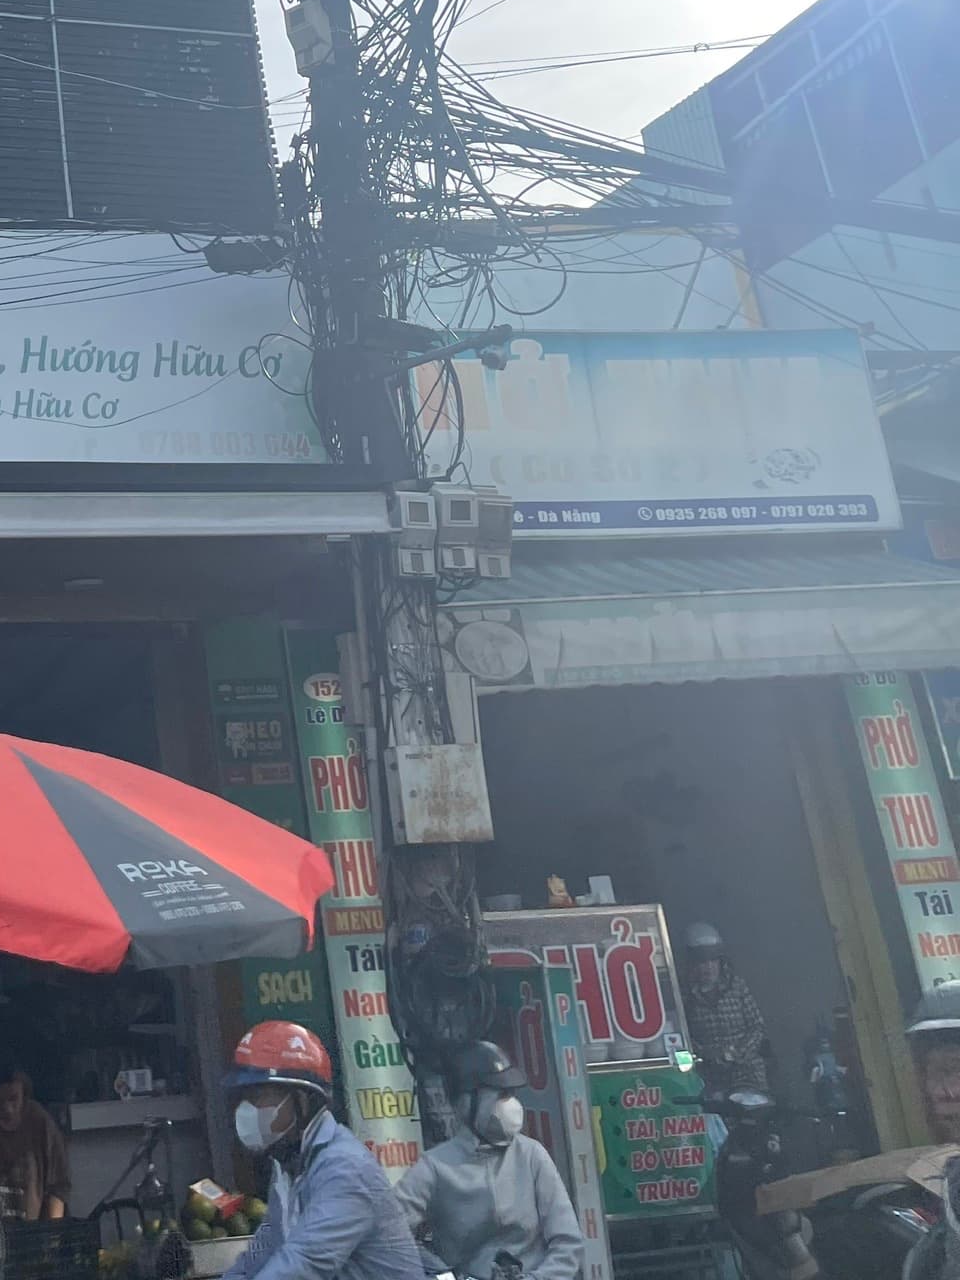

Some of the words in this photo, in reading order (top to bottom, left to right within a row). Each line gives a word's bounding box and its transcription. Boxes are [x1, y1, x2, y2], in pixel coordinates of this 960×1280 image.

[153, 340, 228, 378] Hữu
[239, 344, 283, 379] Cơ
[12, 389, 74, 419] Hữu
[82, 393, 120, 419] Cơ
[310, 680, 342, 697] 152
[863, 701, 920, 768] PHỞ
[309, 738, 368, 812] PHỞ
[882, 796, 940, 849] THU
[117, 859, 208, 883] ROKA
[915, 891, 953, 918] Tái
[335, 911, 383, 933] MENU
[357, 1087, 415, 1120] Viên
